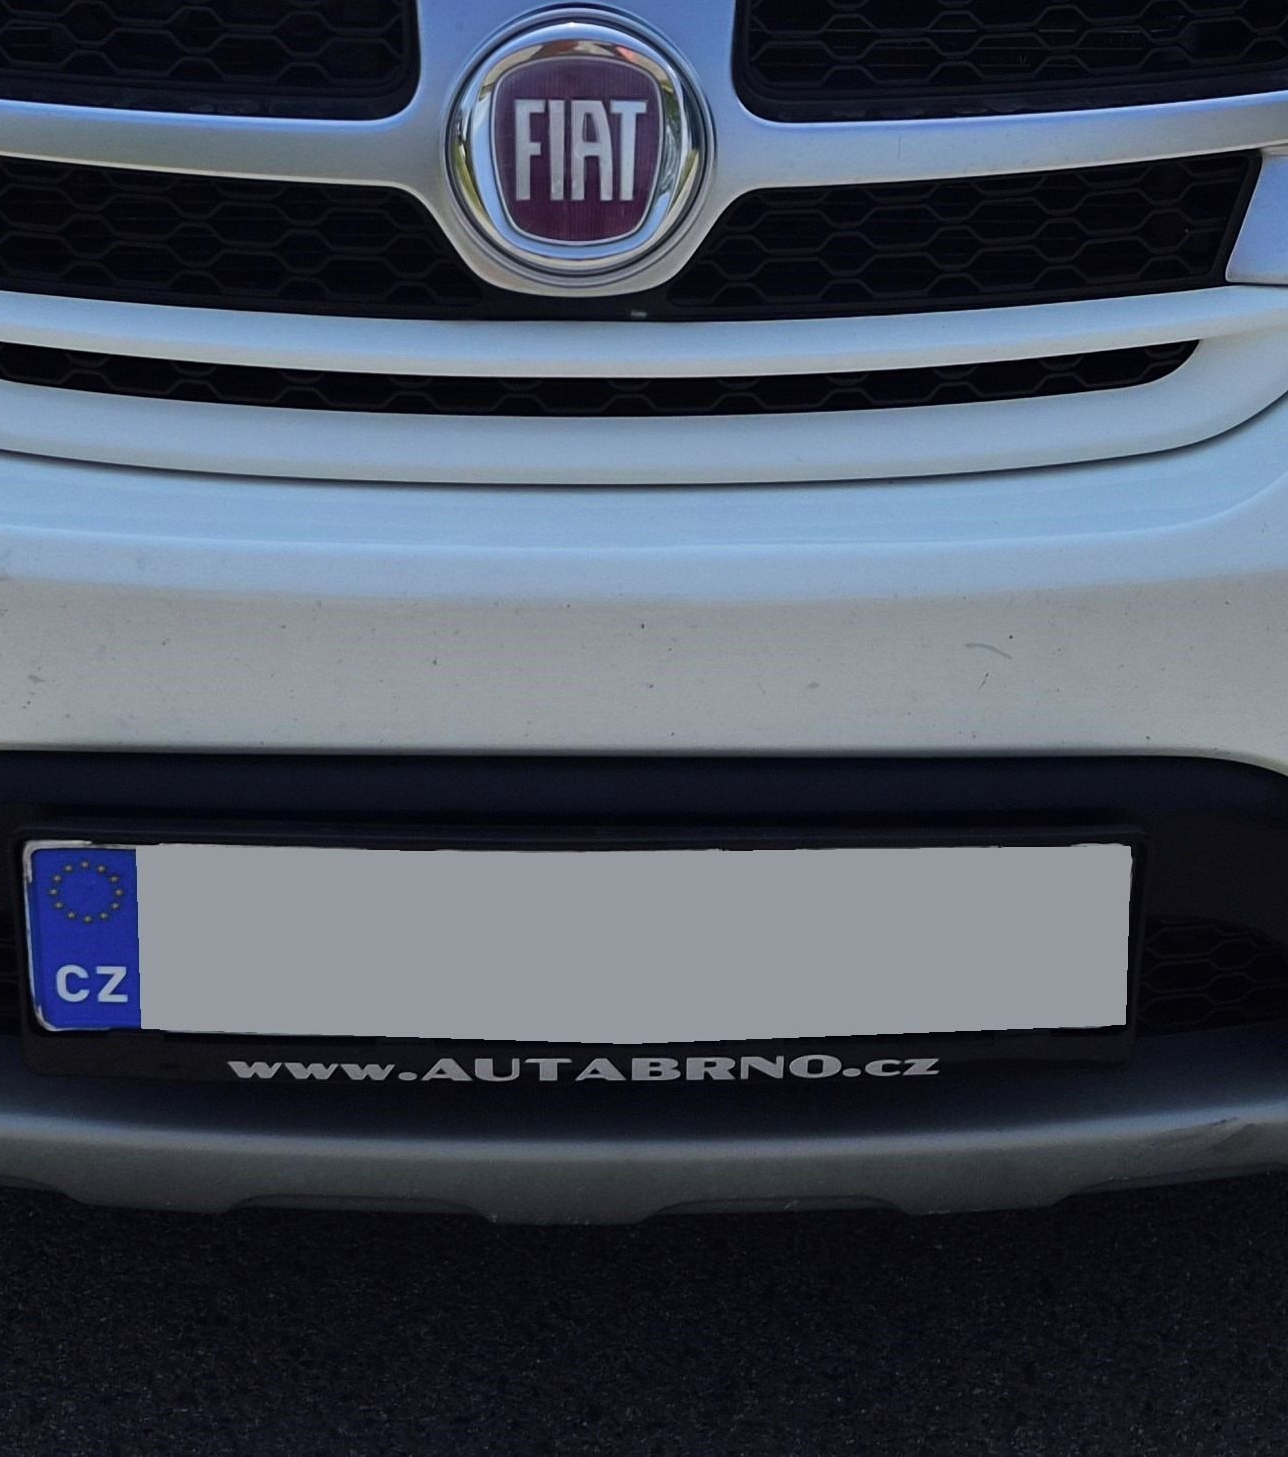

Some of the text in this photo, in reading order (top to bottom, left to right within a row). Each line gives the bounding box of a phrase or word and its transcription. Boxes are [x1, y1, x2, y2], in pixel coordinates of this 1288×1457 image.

[513, 98, 650, 202] FIAT
[55, 964, 129, 1003] CZ
[227, 1054, 940, 1082] www.AUTABRNO.cz
